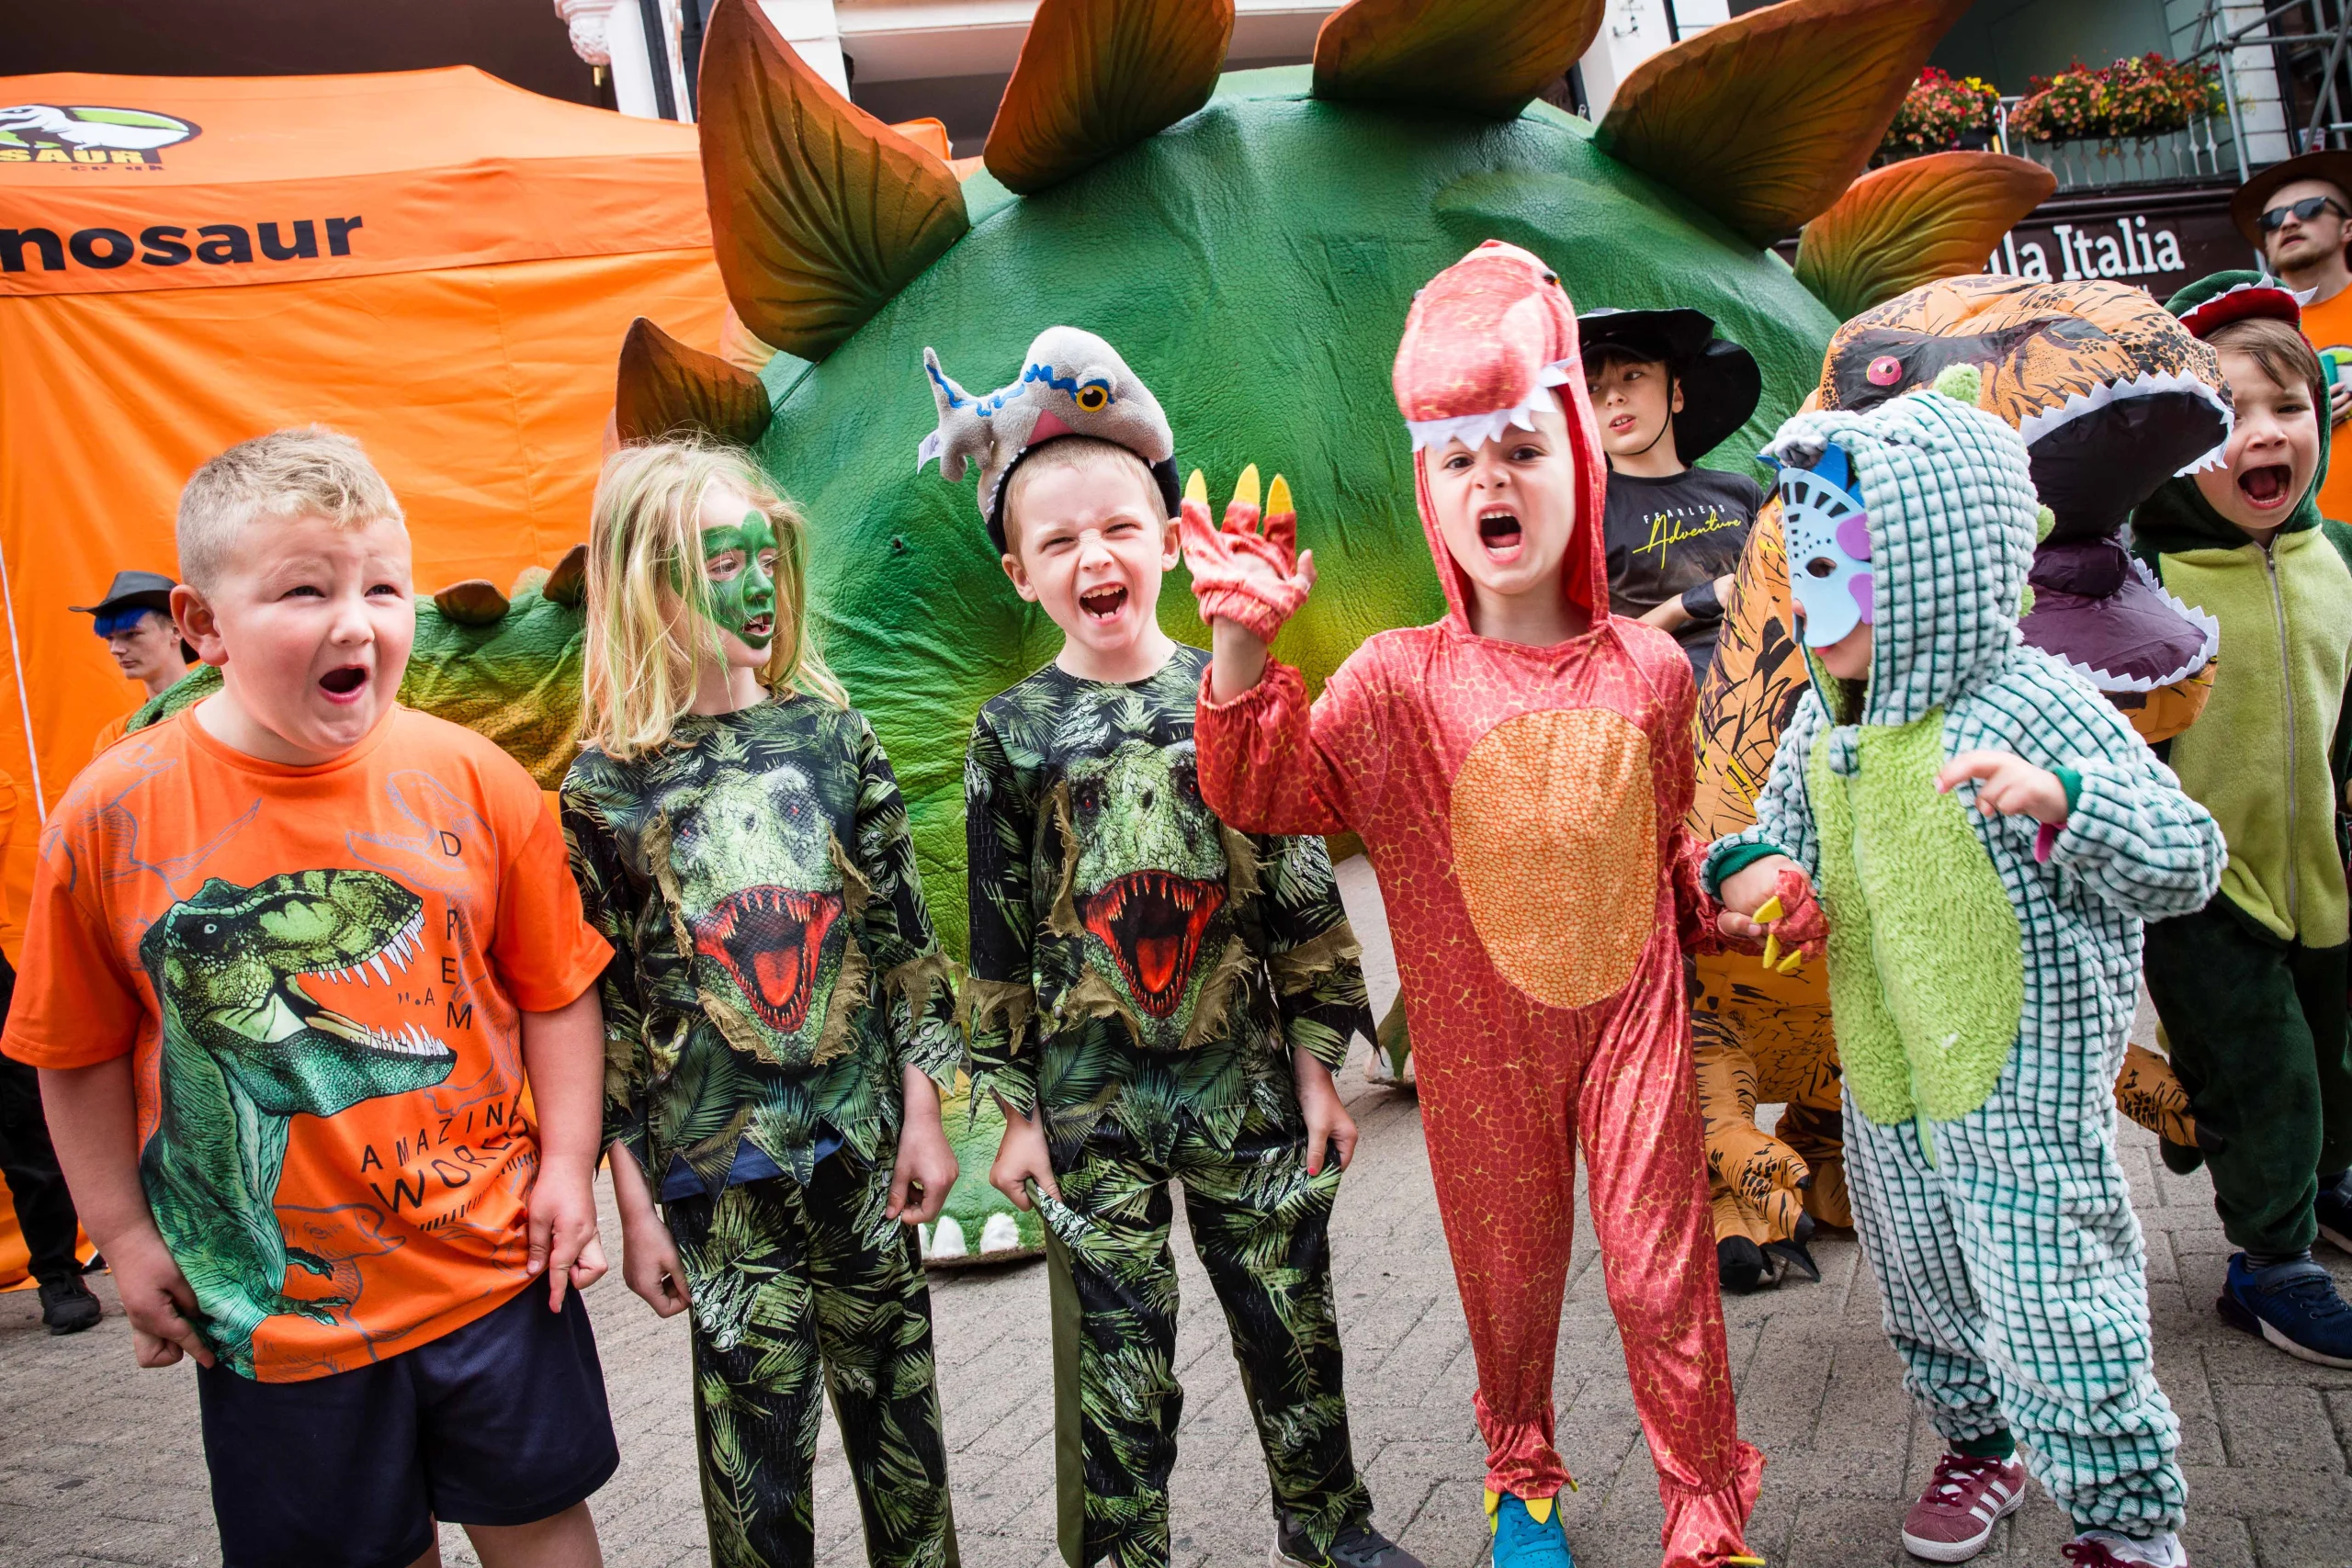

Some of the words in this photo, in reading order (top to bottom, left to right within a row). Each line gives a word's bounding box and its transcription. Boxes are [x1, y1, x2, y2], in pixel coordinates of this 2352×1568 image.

[0, 149, 144, 164] SAUR
[0, 216, 362, 272] nosaur
[2053, 215, 2185, 281] Italia
[1633, 511, 1741, 570] Adventure
[1643, 504, 1725, 525] FEARLESS
[361, 1095, 517, 1173] AMAZIN
